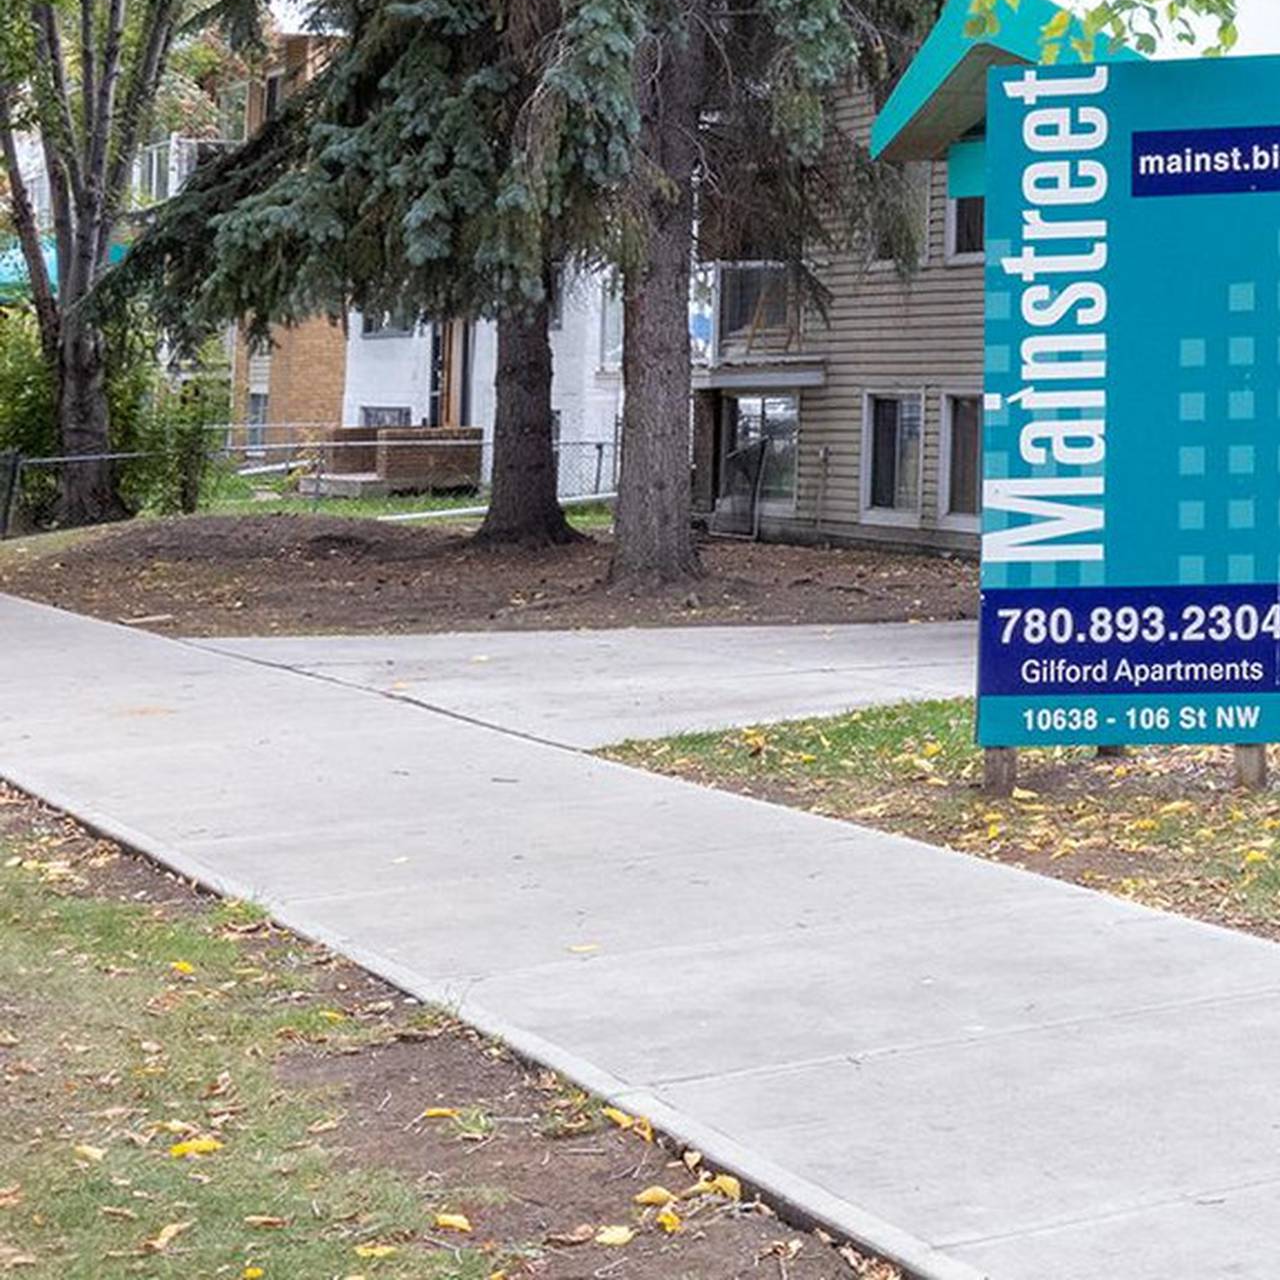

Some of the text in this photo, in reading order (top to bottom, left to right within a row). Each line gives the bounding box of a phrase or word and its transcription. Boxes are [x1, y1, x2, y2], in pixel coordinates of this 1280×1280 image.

[979, 64, 1109, 564] Mainstreet
[1020, 658, 1265, 687] Gilford Apartments
[1022, 707, 1098, 731] 10638
[1125, 706, 1170, 730] 106
[1178, 705, 1207, 730] St
[1215, 705, 1261, 729] NW
